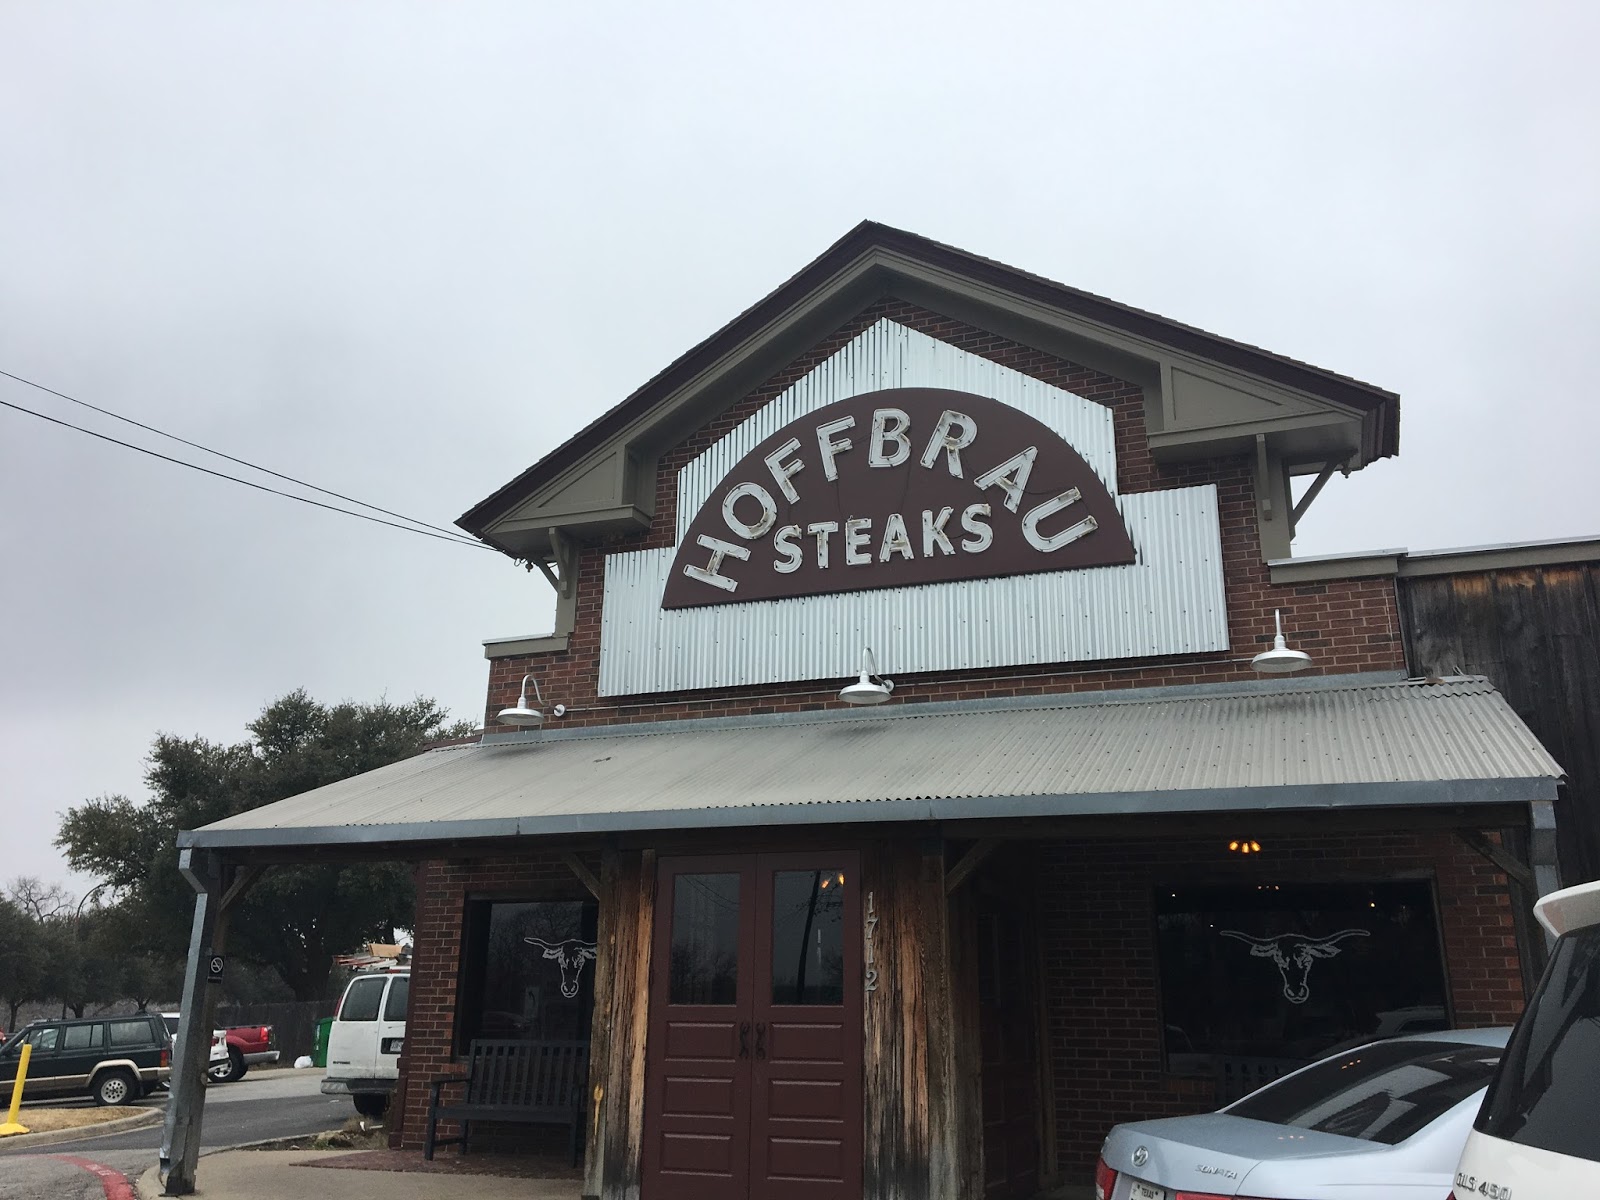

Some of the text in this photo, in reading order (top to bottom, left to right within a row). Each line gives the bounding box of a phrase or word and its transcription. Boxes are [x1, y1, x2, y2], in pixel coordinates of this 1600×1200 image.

[683, 408, 1099, 593] HOFFBRAU
[773, 503, 994, 574] STEAKS
[865, 891, 879, 991] 1712
[1195, 1164, 1237, 1179] SONATA
[1478, 1181, 1512, 1200] 450
